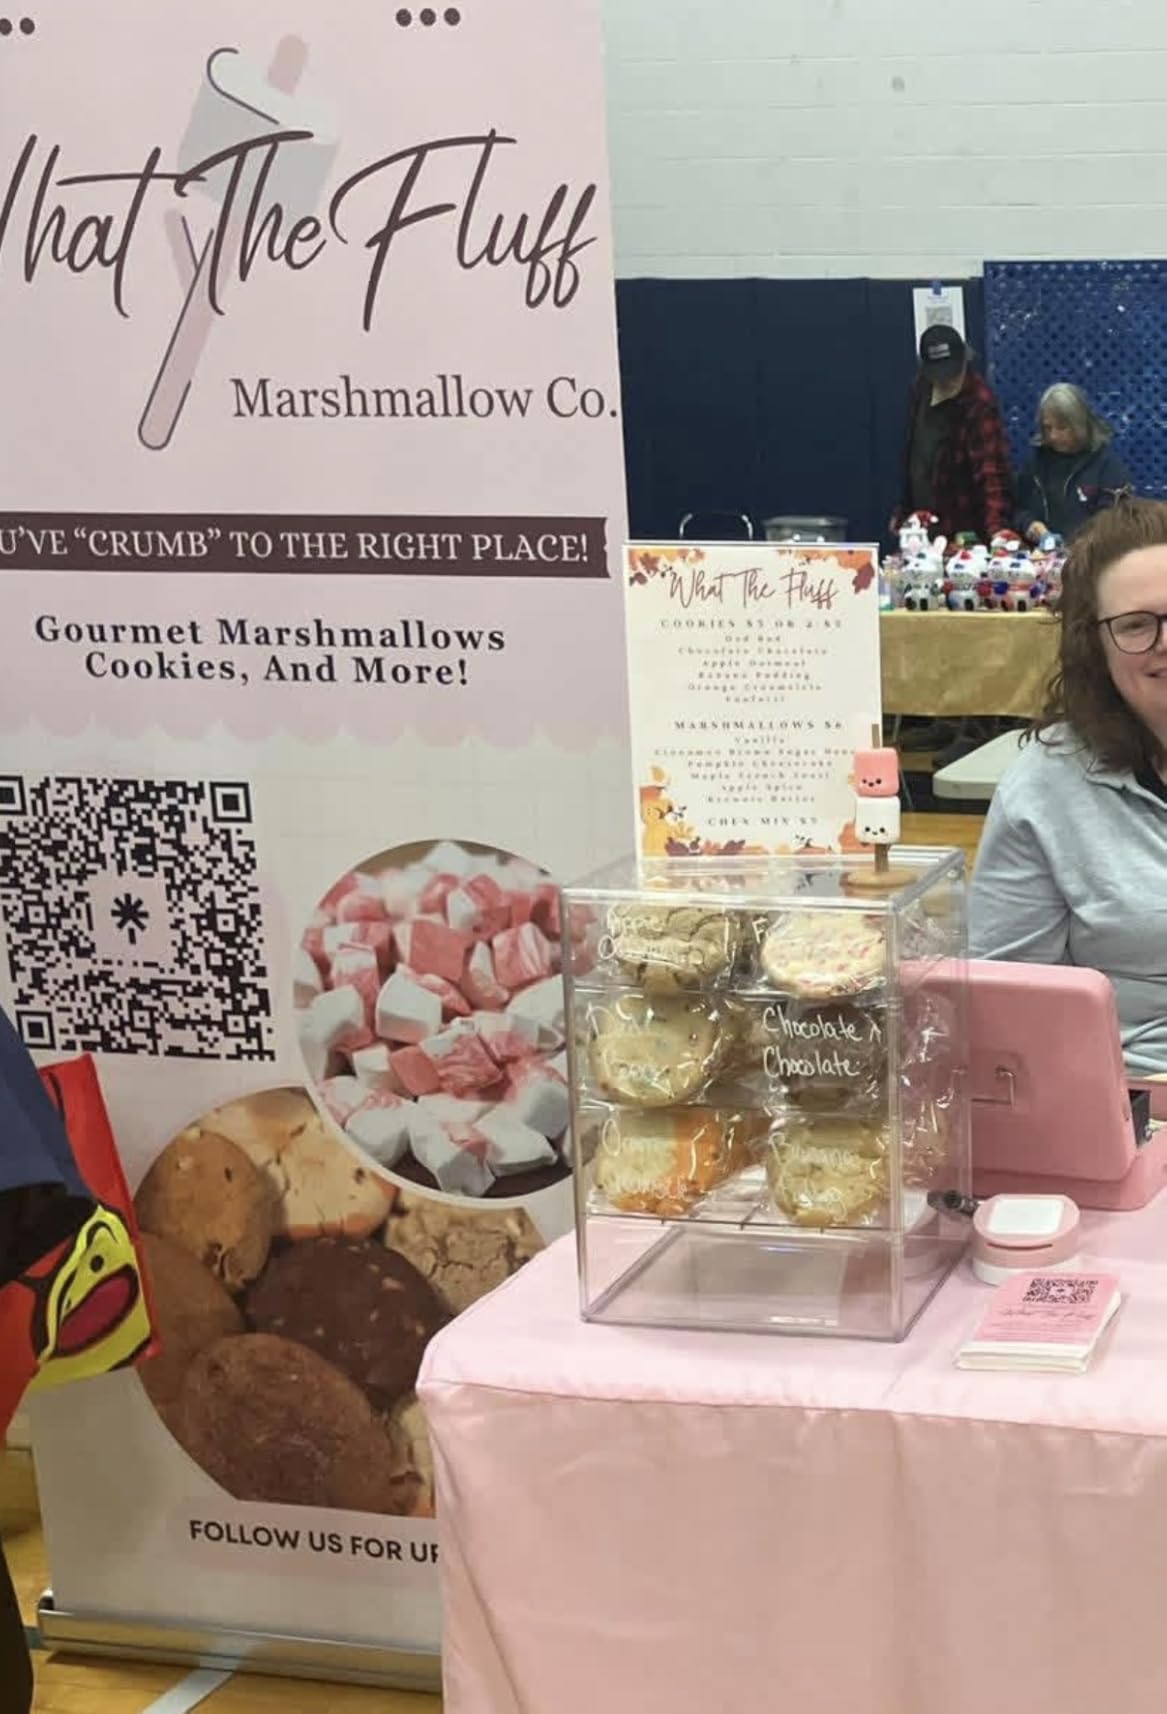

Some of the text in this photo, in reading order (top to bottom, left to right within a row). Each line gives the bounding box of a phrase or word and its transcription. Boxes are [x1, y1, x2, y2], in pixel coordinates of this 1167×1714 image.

[0, 128, 596, 332] hat The Fluff
[230, 374, 617, 418] Marshmallow Co.
[73, 526, 222, 557] “CRUMB”
[229, 531, 273, 558] TO
[279, 532, 349, 559] THE
[357, 532, 462, 560] RIGHT
[471, 533, 588, 562] PLACE!
[669, 567, 839, 610] What The Fluff
[35, 615, 505, 651] Gourmet Marshmallows
[660, 618, 736, 629] COOKIES
[85, 651, 467, 686] Cookies, And More!
[674, 720, 816, 730] MARSHMALLOWS
[762, 1004, 863, 1042] Chocolate
[763, 1045, 861, 1078] Chocolate
[189, 1519, 300, 1550] FOLLOW
[308, 1530, 343, 1554] US
[350, 1535, 403, 1561] FOR
